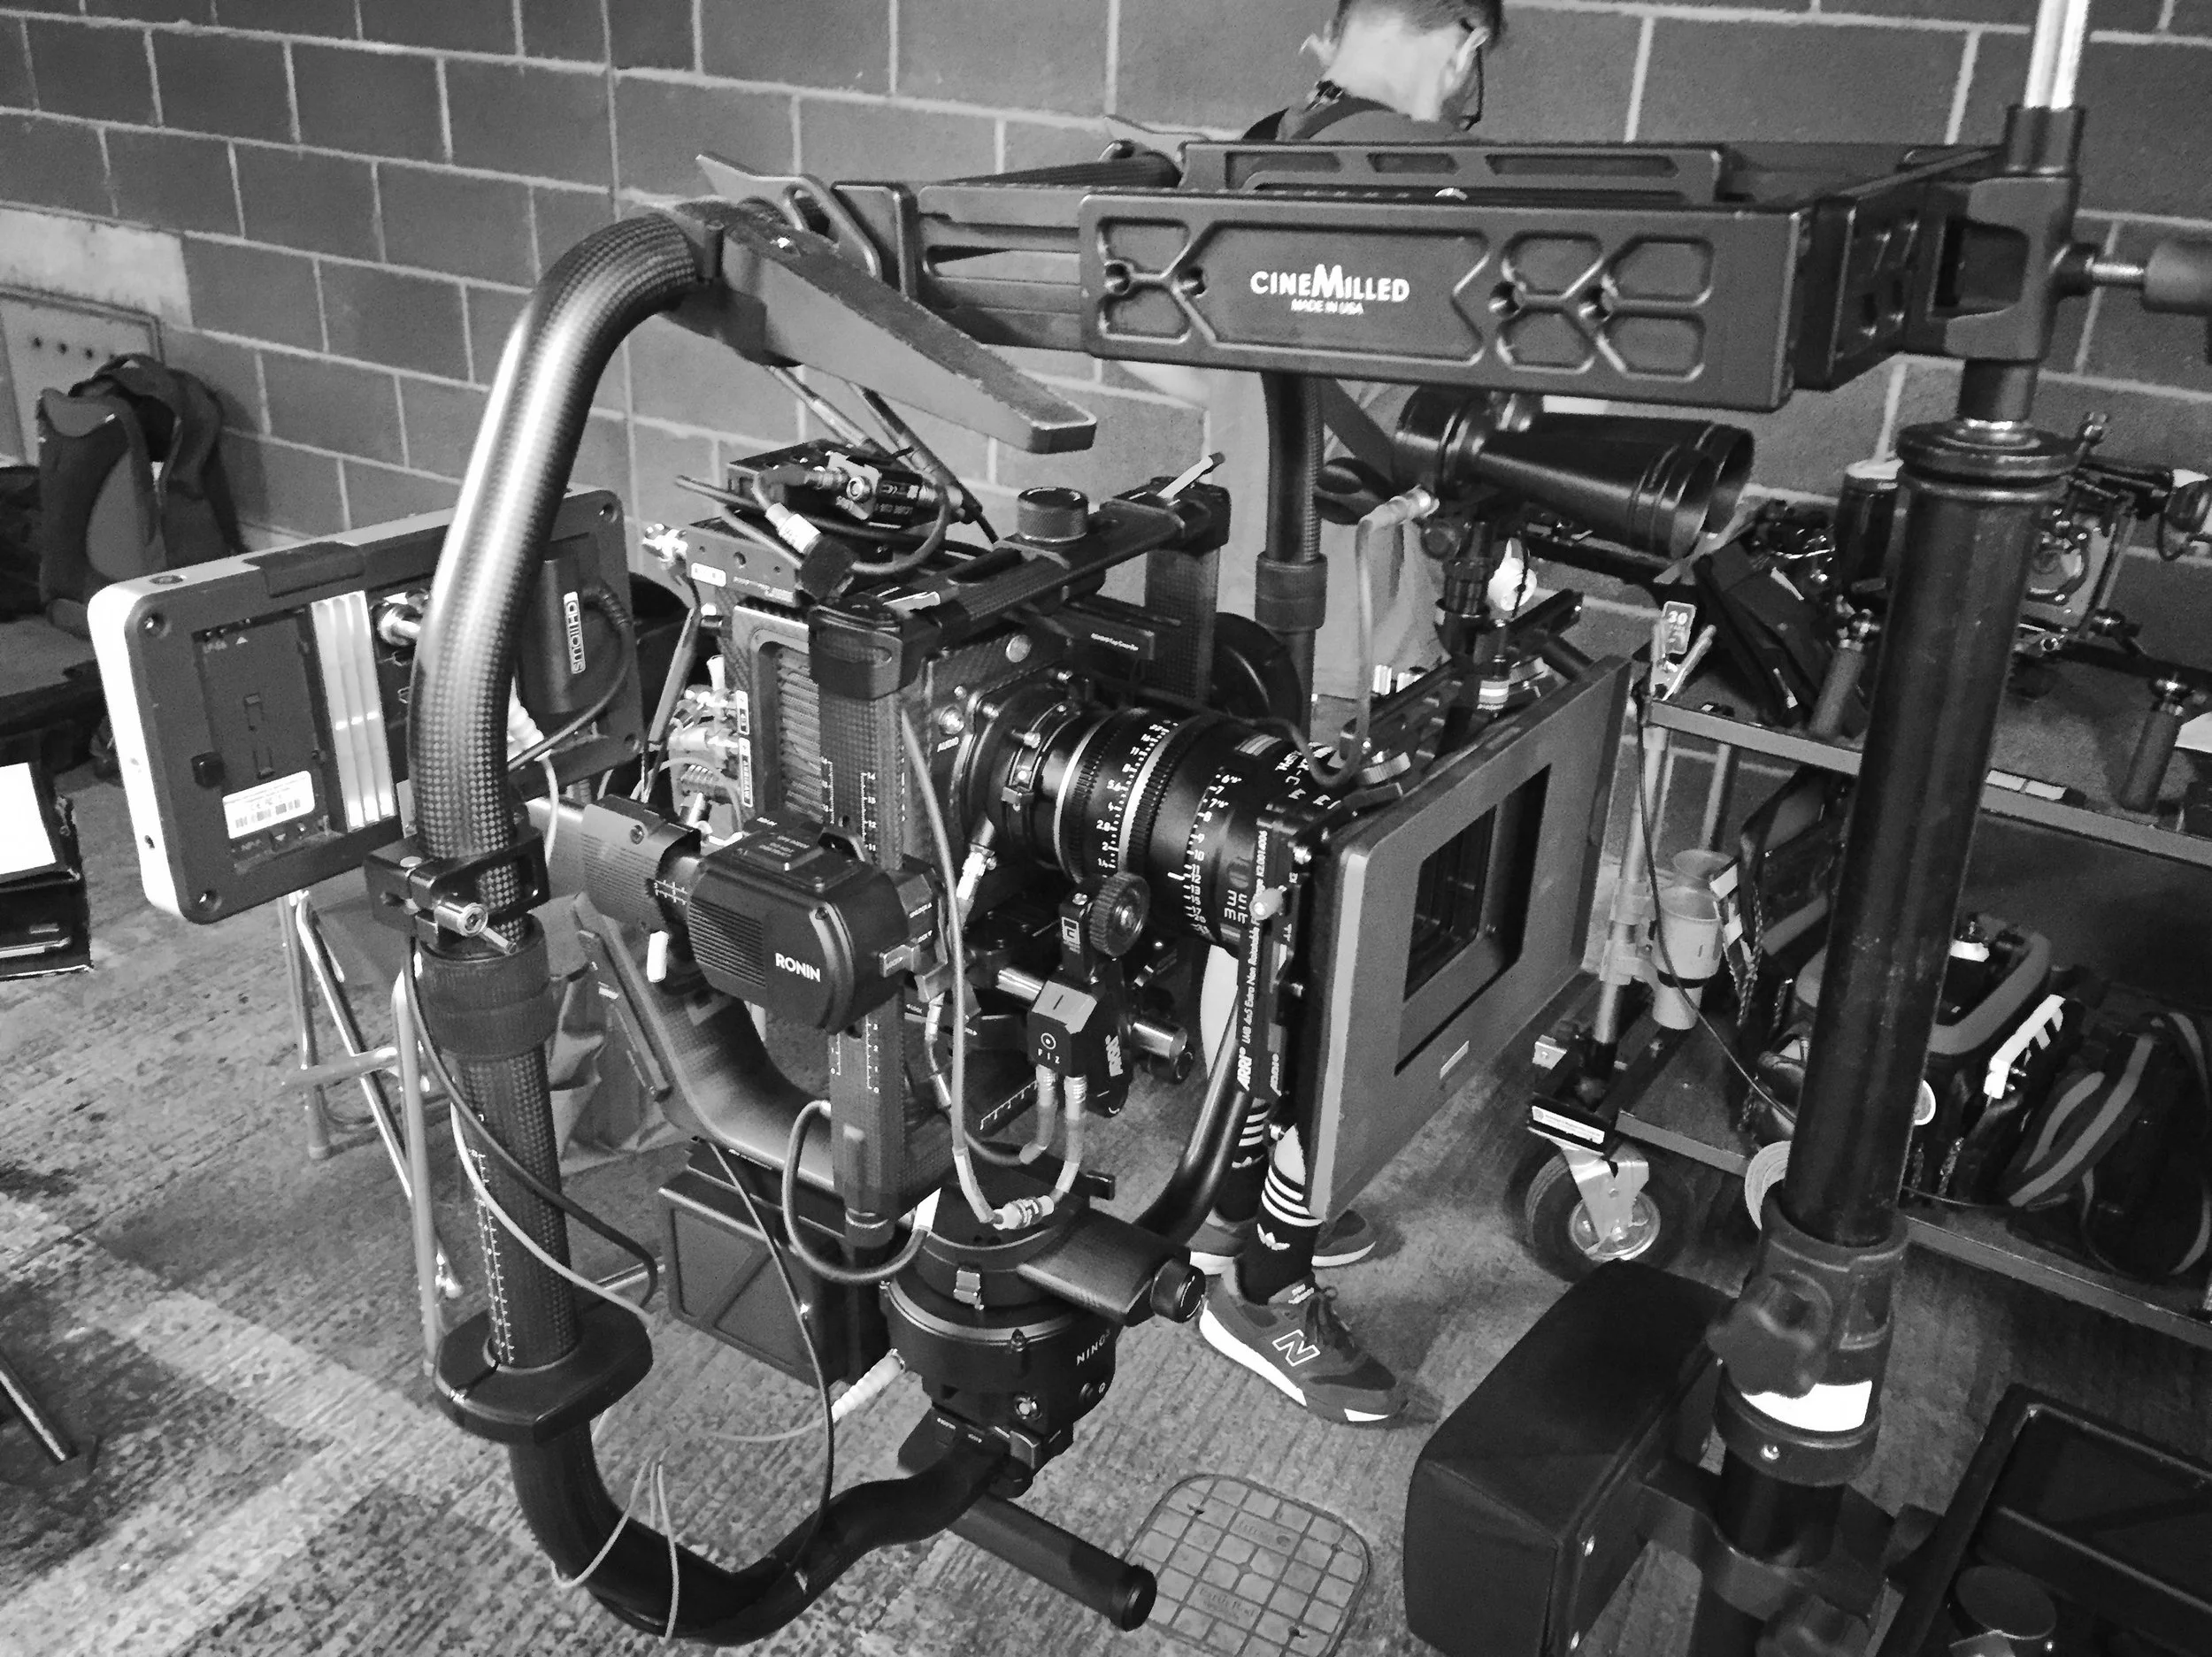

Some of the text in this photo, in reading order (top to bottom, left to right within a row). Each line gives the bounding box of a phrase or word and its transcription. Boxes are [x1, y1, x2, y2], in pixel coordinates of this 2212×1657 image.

[1291, 298, 1364, 316] MADE IN USA
[566, 602, 585, 672] smallHD
[775, 952, 821, 982] RONIN
[1237, 1051, 1252, 1092] ARRI
[1246, 966, 1256, 986] Non
